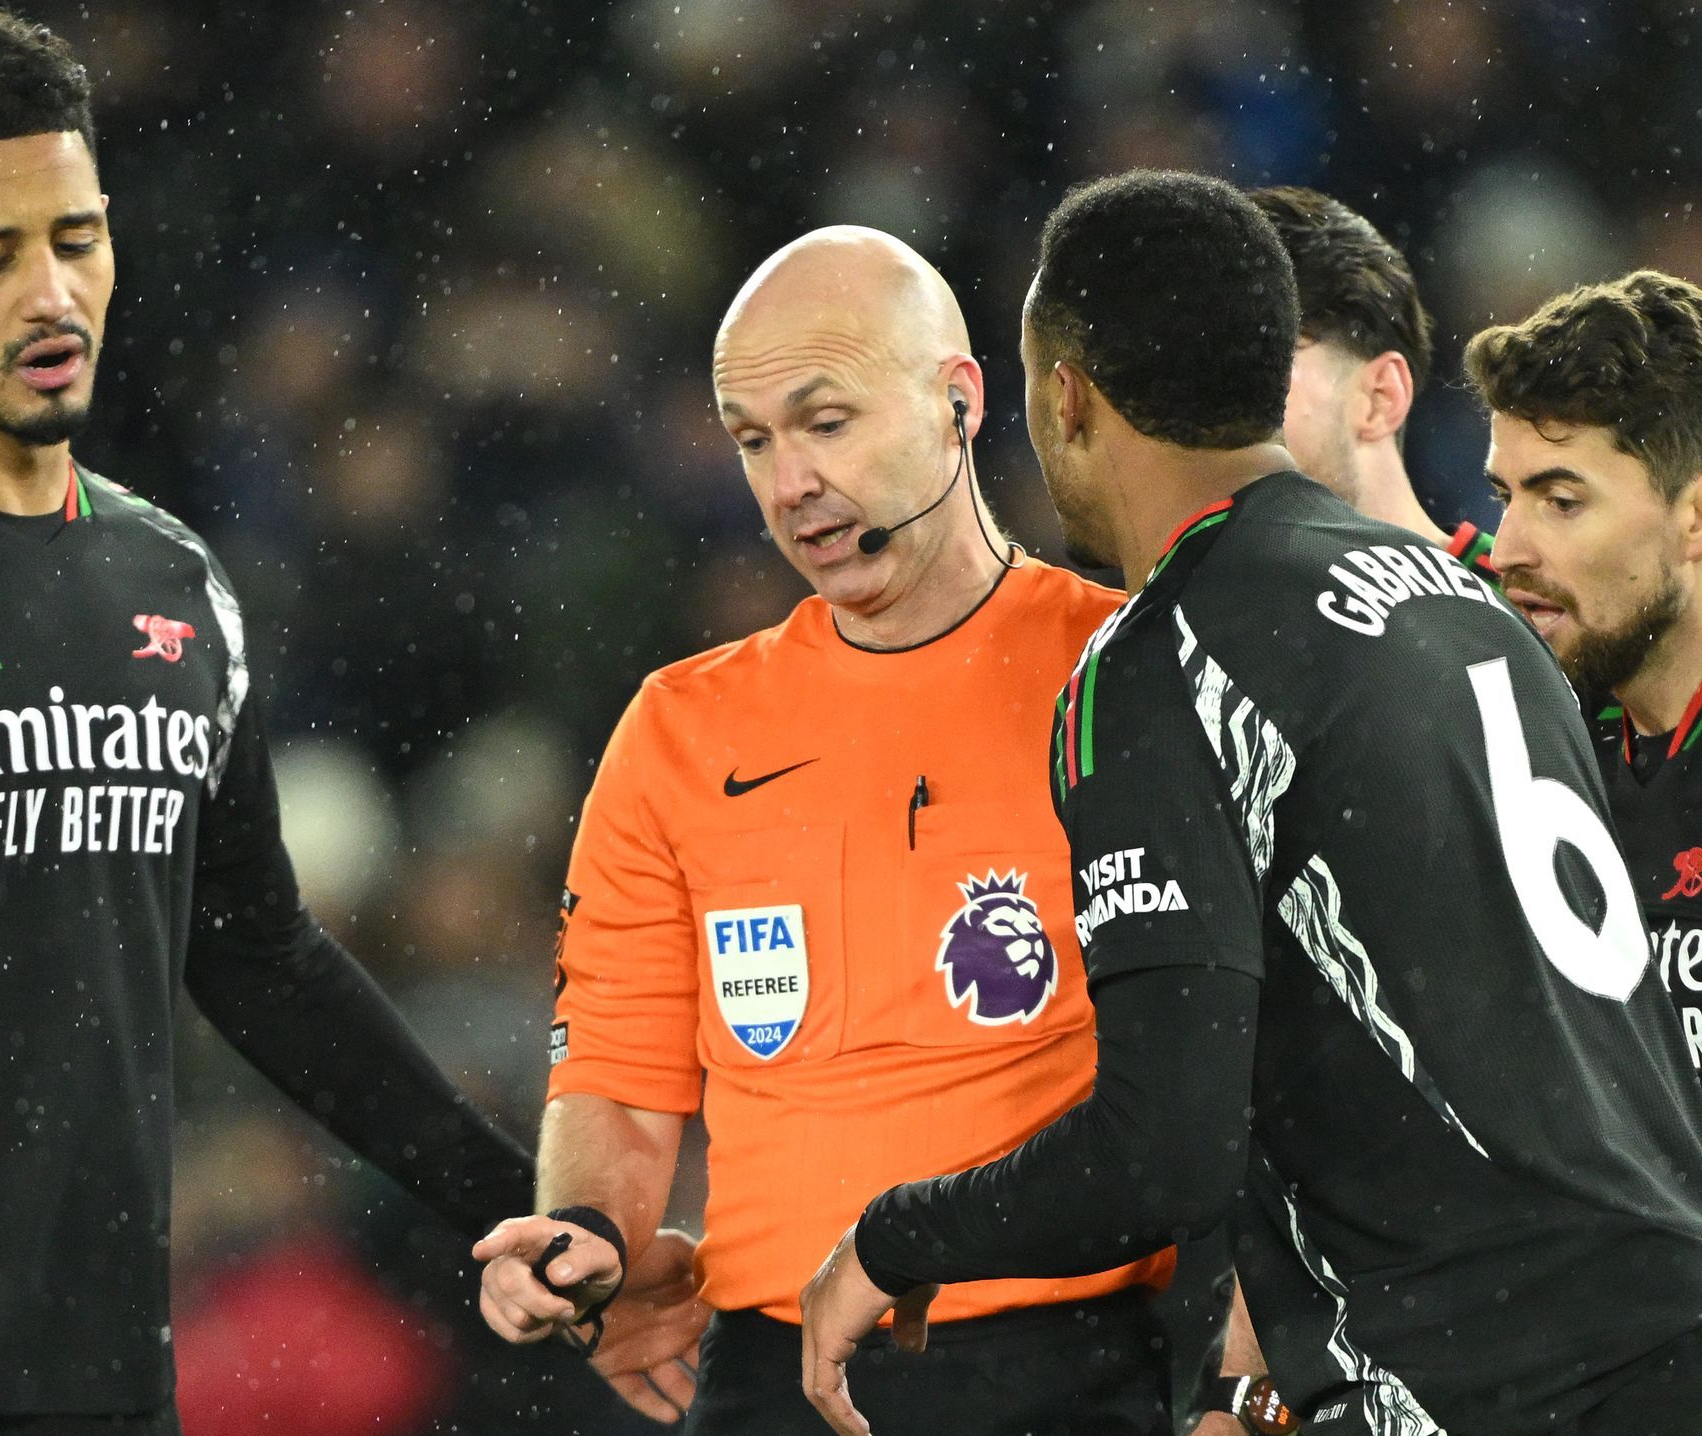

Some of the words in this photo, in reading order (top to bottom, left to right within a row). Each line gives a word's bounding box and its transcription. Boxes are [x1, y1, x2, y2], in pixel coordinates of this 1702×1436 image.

[61, 786, 186, 856] BETTER
[1466, 656, 1651, 1004] 6
[1079, 847, 1145, 896] VISIT
[715, 915, 795, 955] FIFA
[1074, 880, 1190, 948] RWANDA
[722, 975, 800, 998] REFEREE
[747, 1026, 783, 1044] 2024
